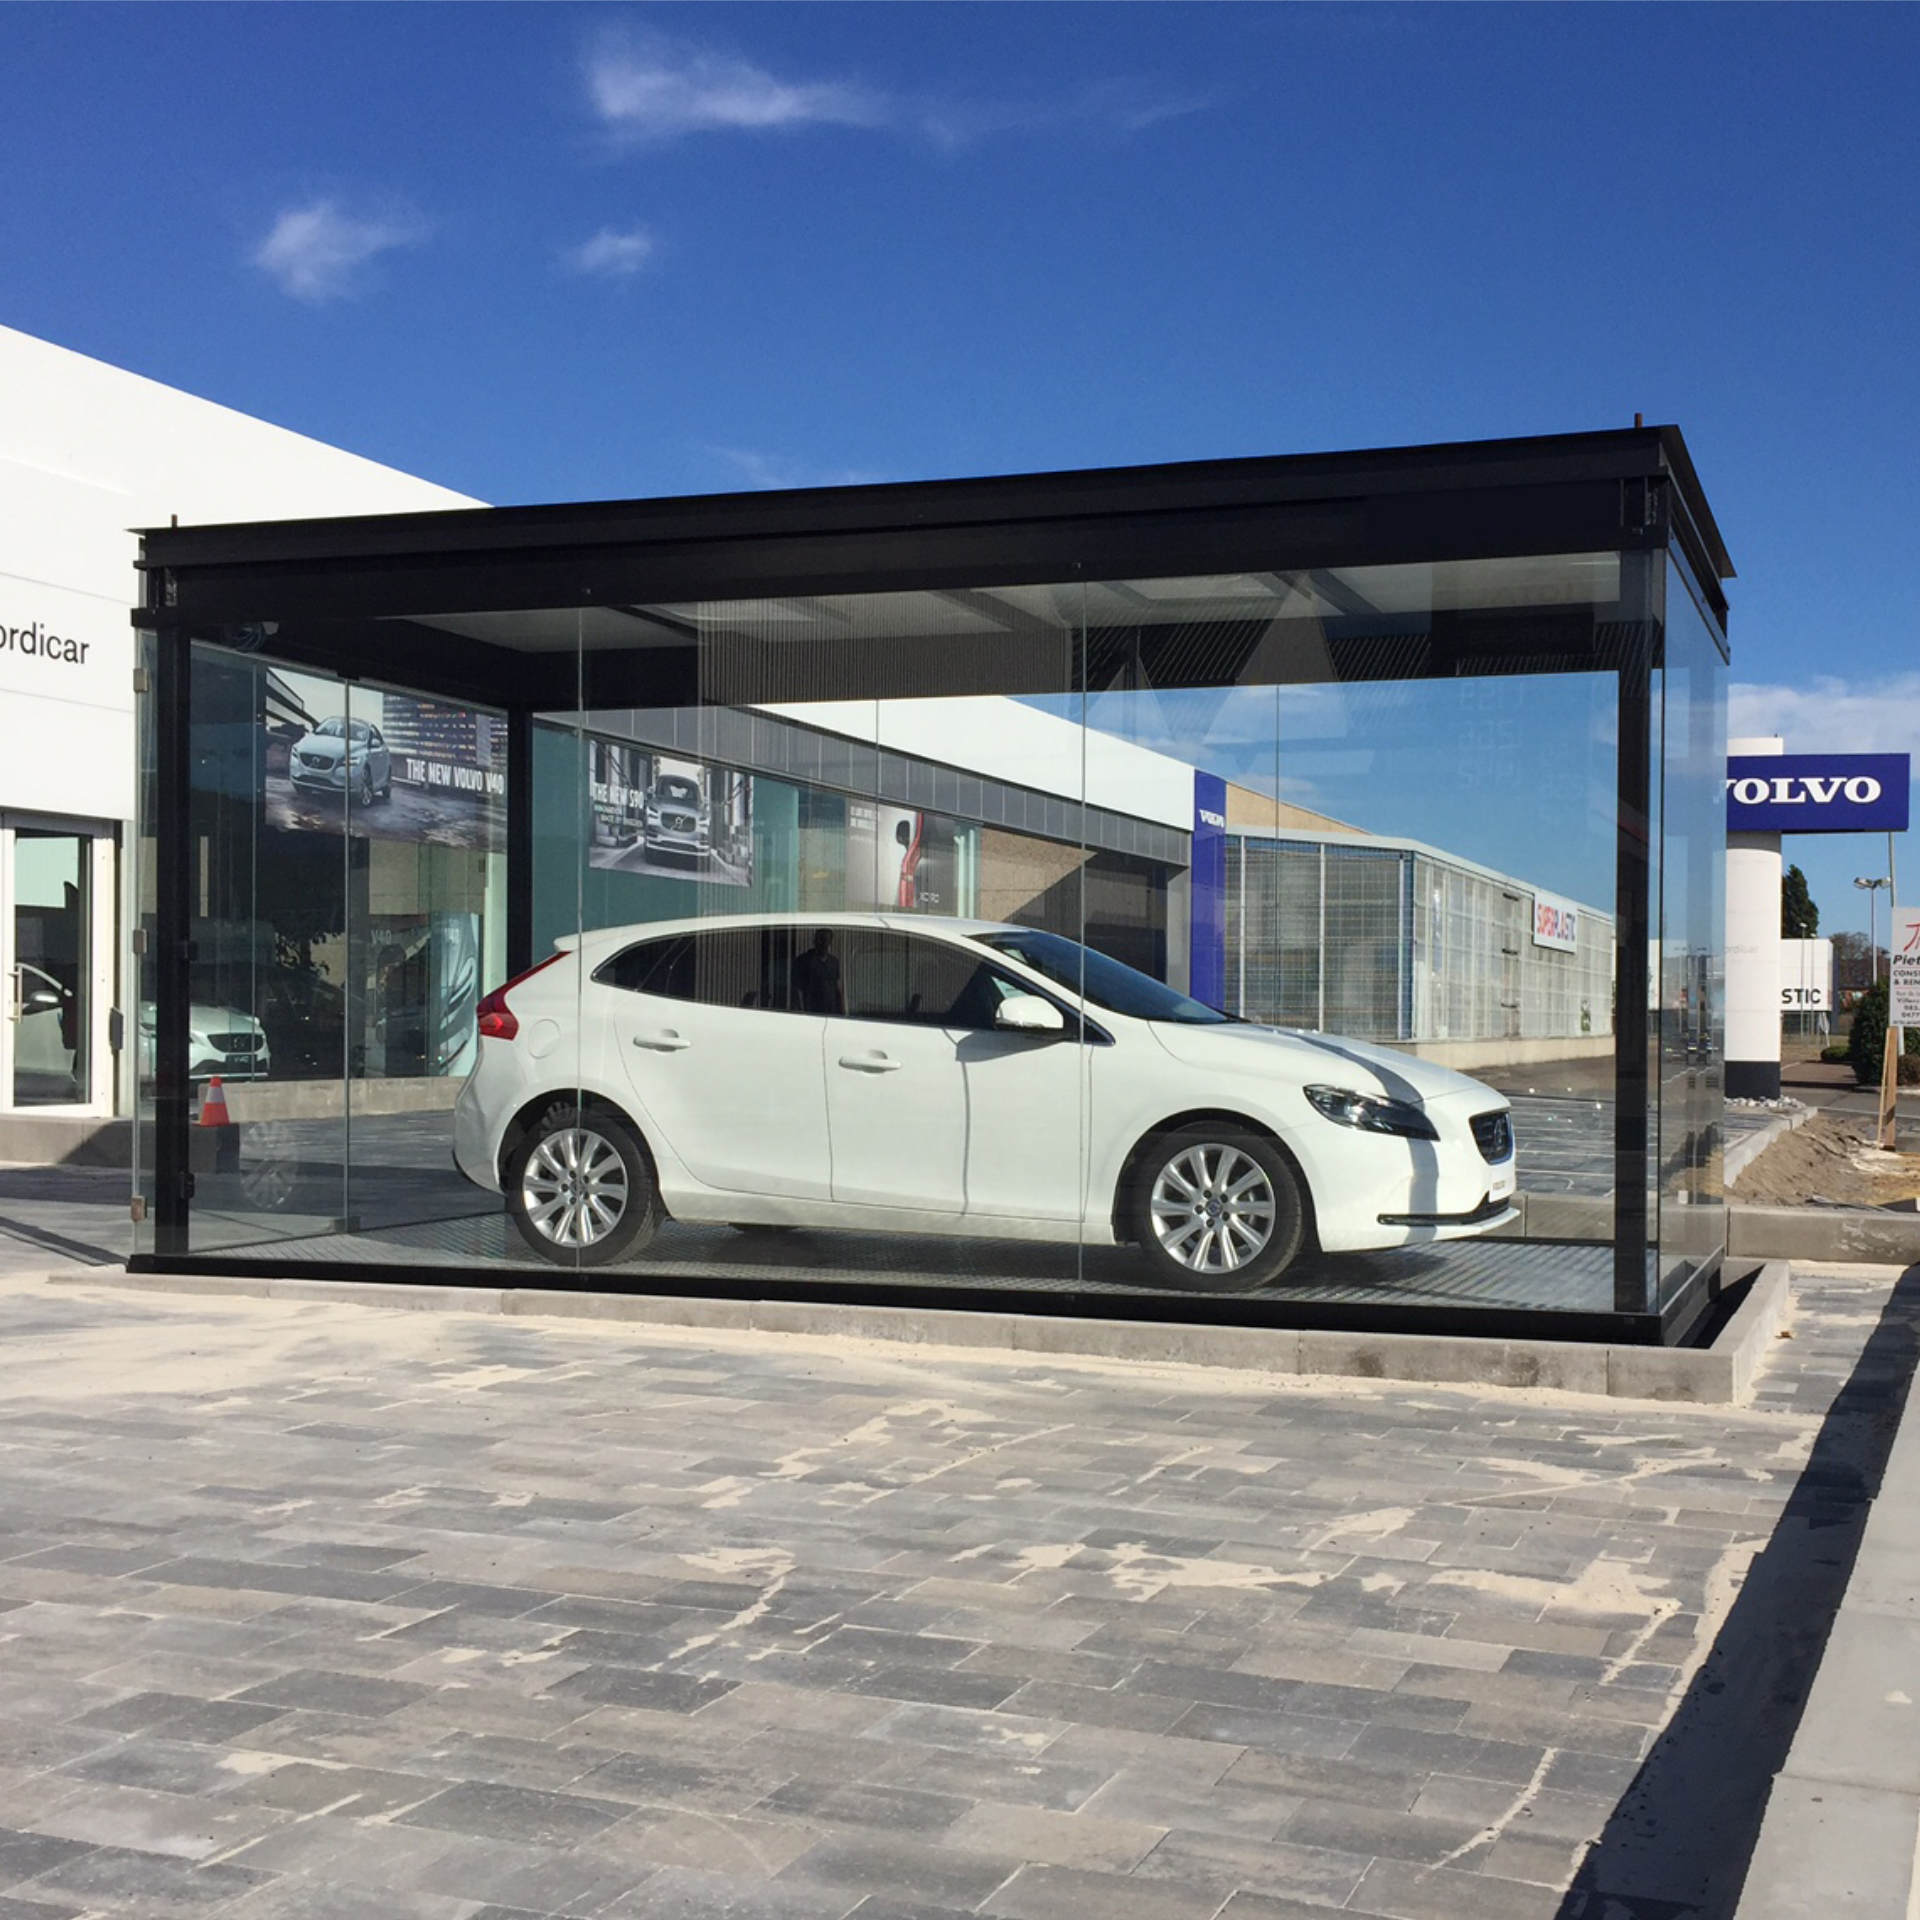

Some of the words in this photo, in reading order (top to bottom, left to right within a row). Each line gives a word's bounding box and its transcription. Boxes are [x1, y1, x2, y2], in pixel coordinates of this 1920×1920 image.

[406, 758, 427, 782] THE
[427, 761, 452, 786] NEW
[453, 766, 484, 792] VOLVO
[485, 772, 505, 795] V40
[1781, 988, 1822, 1004] STIC
